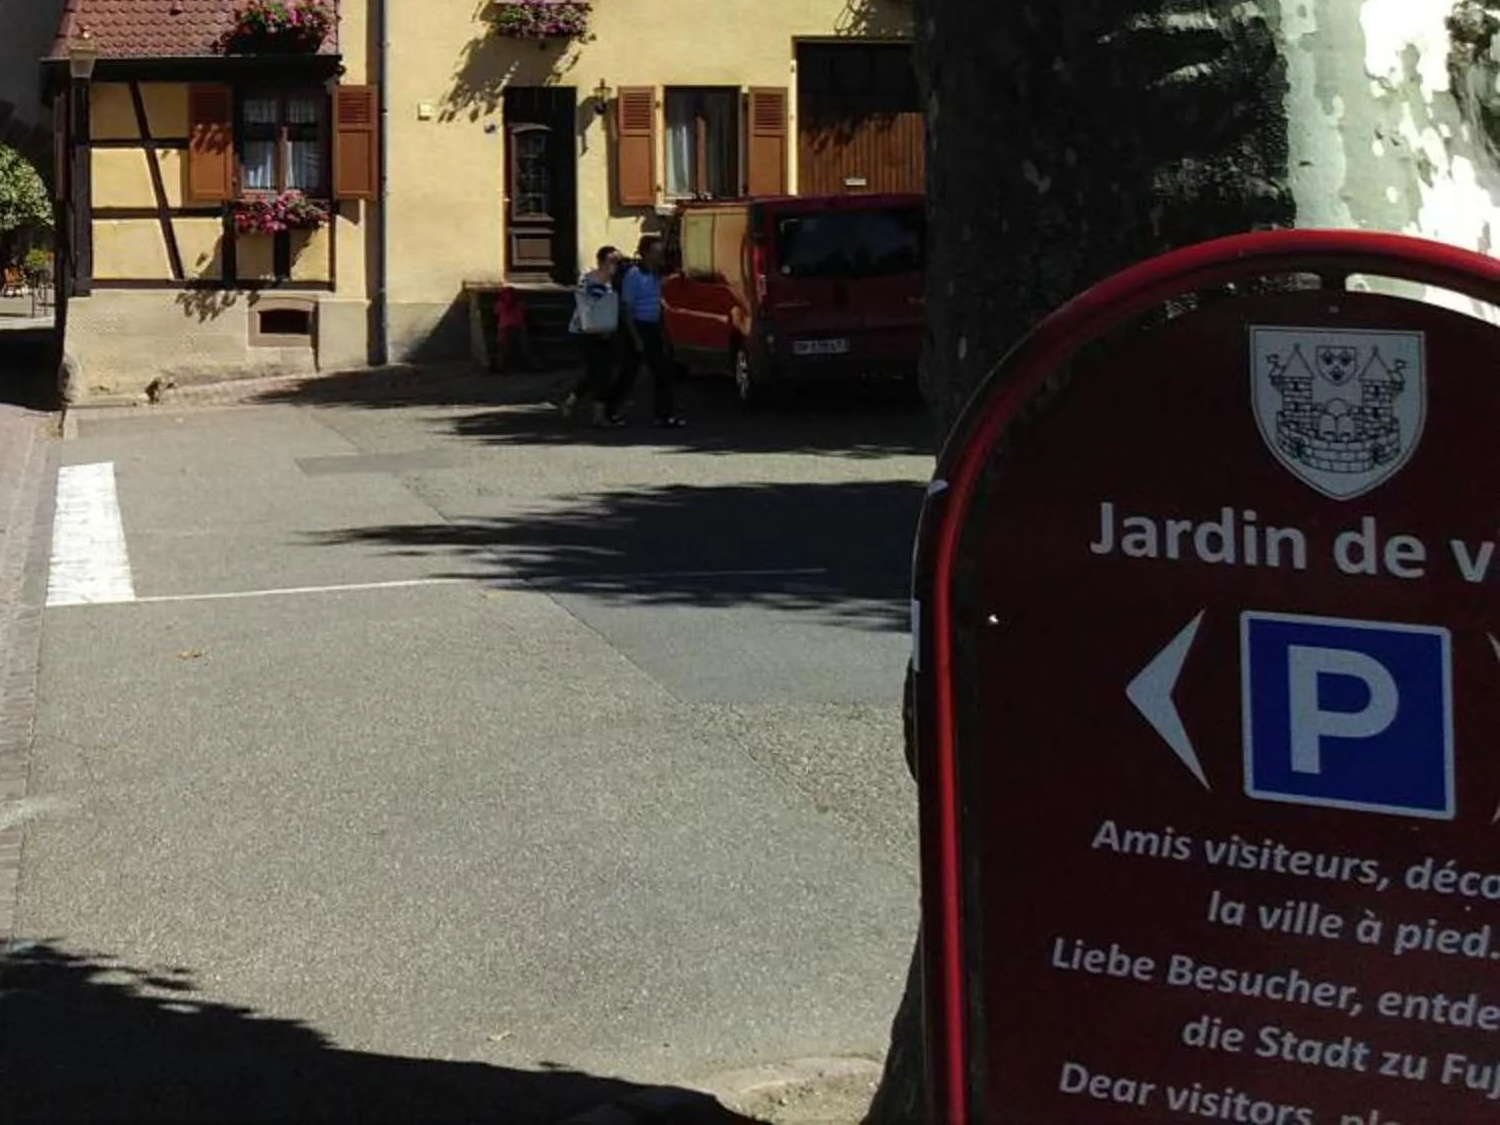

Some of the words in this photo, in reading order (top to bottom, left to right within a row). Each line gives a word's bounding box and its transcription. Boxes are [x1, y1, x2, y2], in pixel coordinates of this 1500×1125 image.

[1090, 501, 1307, 570] Jardin
[1334, 515, 1426, 579] de
[1449, 537, 1500, 583] v
[1288, 644, 1400, 775] P
[1091, 819, 1192, 861] Amis
[1204, 833, 1390, 893] visiteurs,
[1208, 889, 1246, 926] la
[1258, 898, 1344, 939] ville
[1356, 908, 1383, 944] à
[1052, 937, 1156, 982] Liebe
[1167, 955, 1364, 1018] Besucher,
[1377, 991, 1500, 1030] entde
[1059, 1062, 1157, 1106] Dear
[1183, 1014, 1245, 1053] die
[1254, 1025, 1371, 1072] Stadt
[1378, 1051, 1429, 1081] zu
